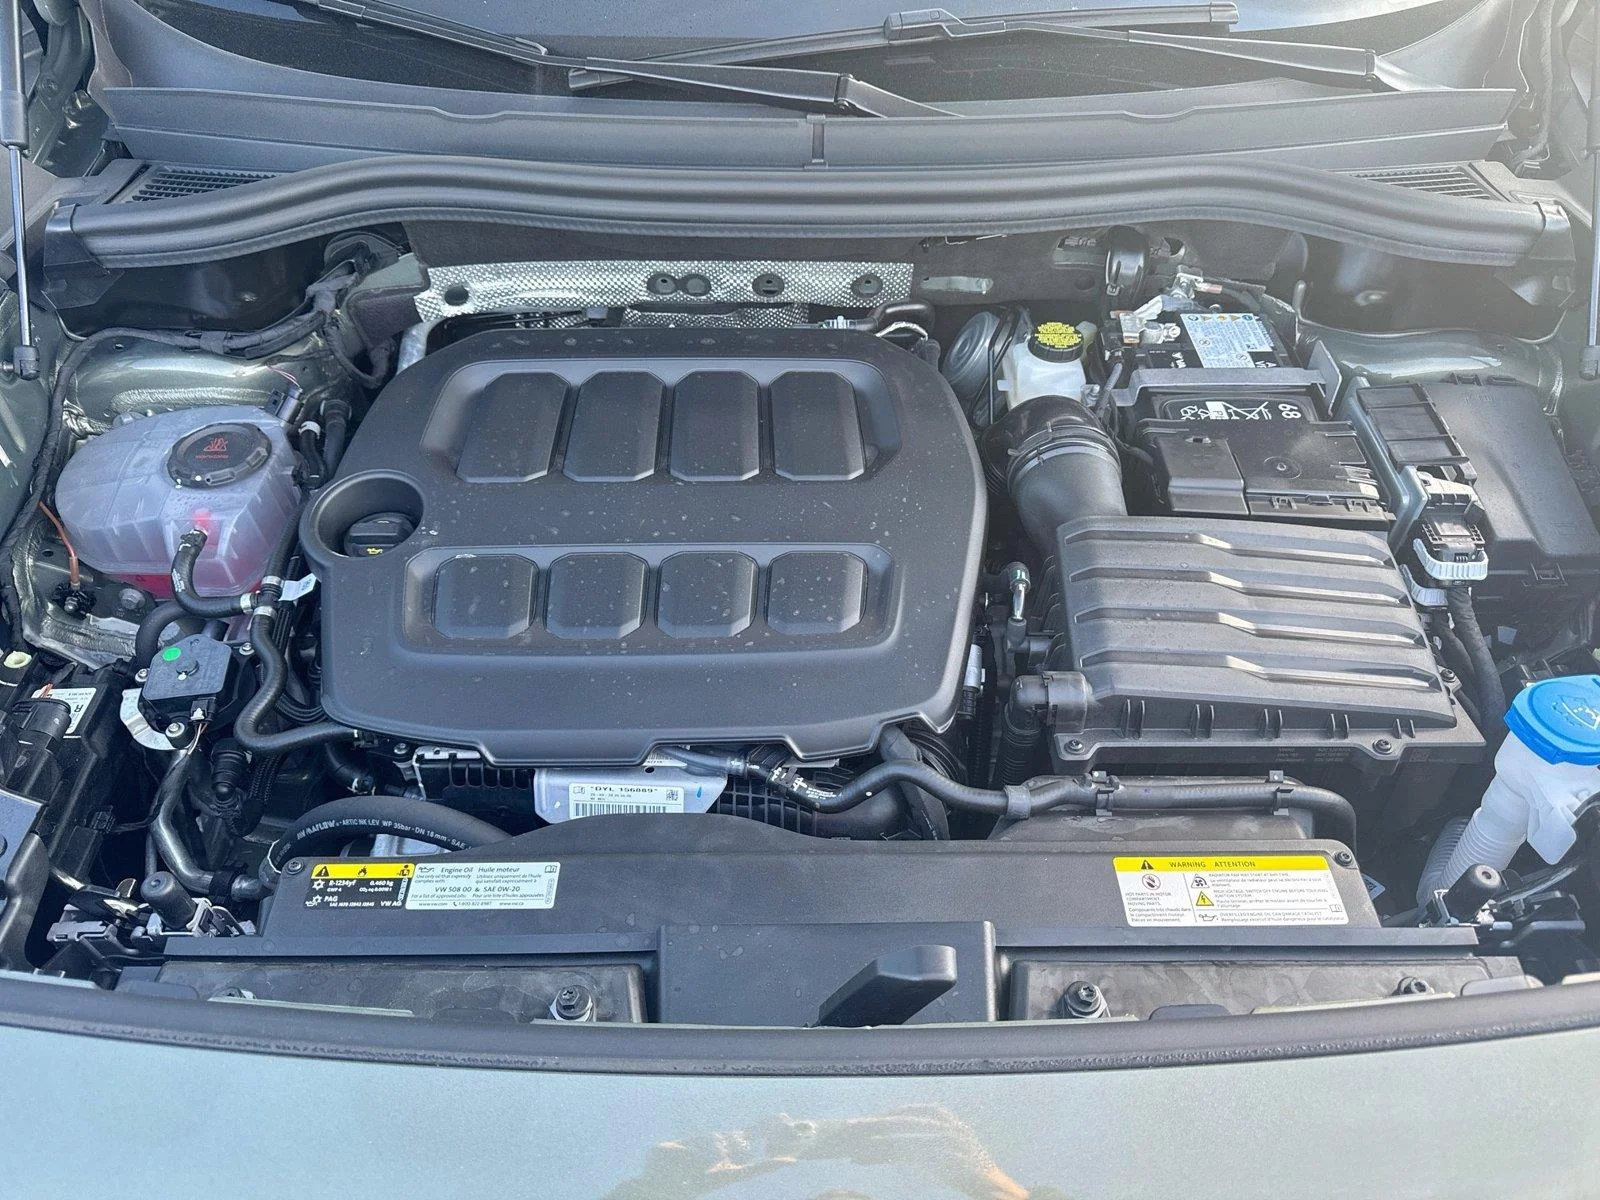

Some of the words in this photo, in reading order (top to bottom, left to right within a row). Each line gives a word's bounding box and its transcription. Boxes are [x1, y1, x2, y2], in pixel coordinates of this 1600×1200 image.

[1278, 403, 1302, 419] 68
[382, 820, 393, 828] WP
[441, 867, 463, 876] Engine
[463, 866, 474, 874] Oil
[478, 866, 496, 874] Huile
[495, 866, 521, 874] moteur
